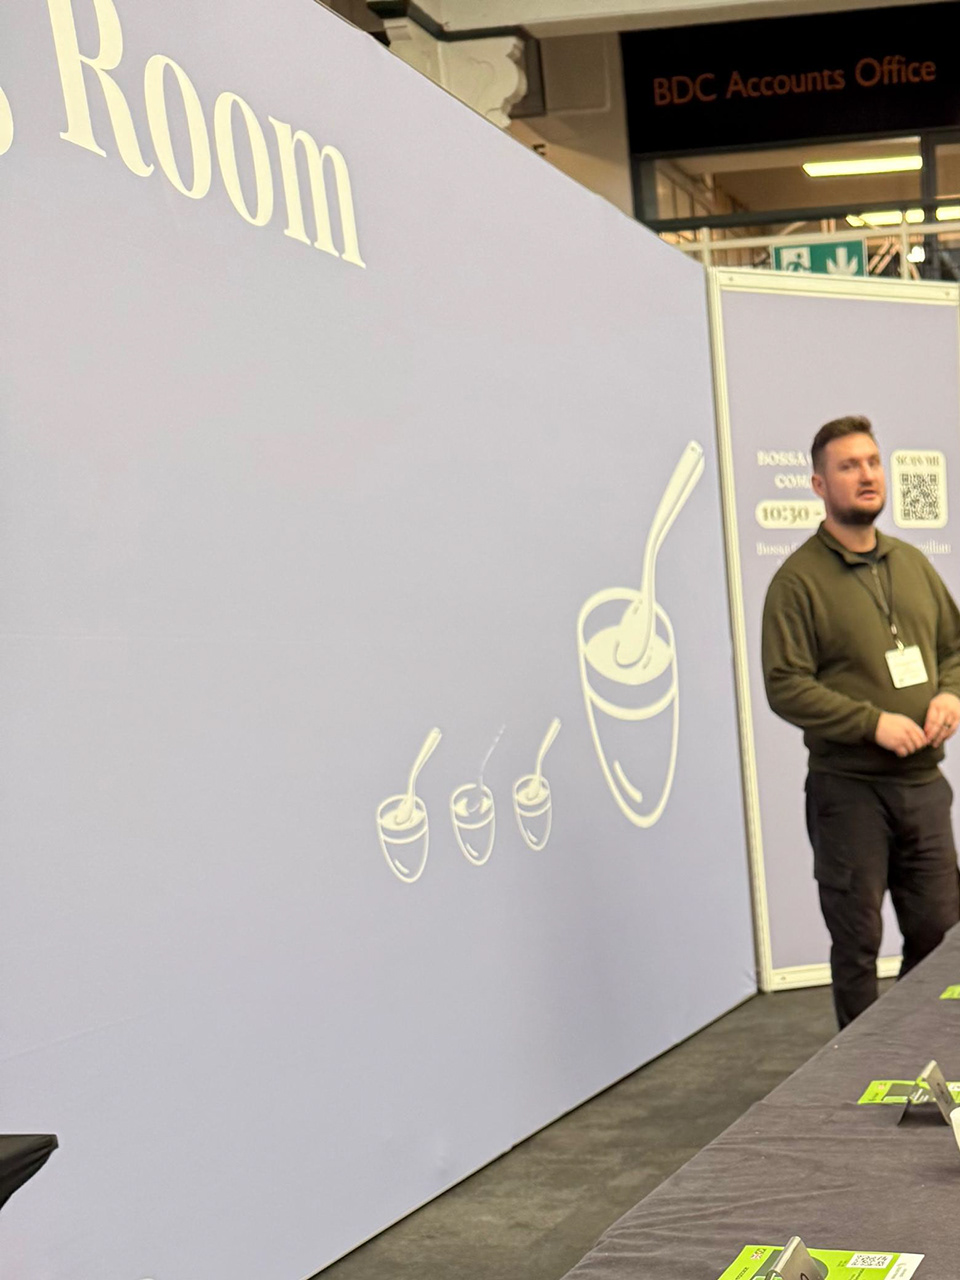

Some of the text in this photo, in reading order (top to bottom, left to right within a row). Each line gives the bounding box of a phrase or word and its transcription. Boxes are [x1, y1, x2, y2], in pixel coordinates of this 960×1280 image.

[653, 56, 937, 105] BDC Accounts Office
[48, 0, 366, 269] Room
[757, 451, 806, 466] BOSSA
[762, 505, 810, 523] 10:30
